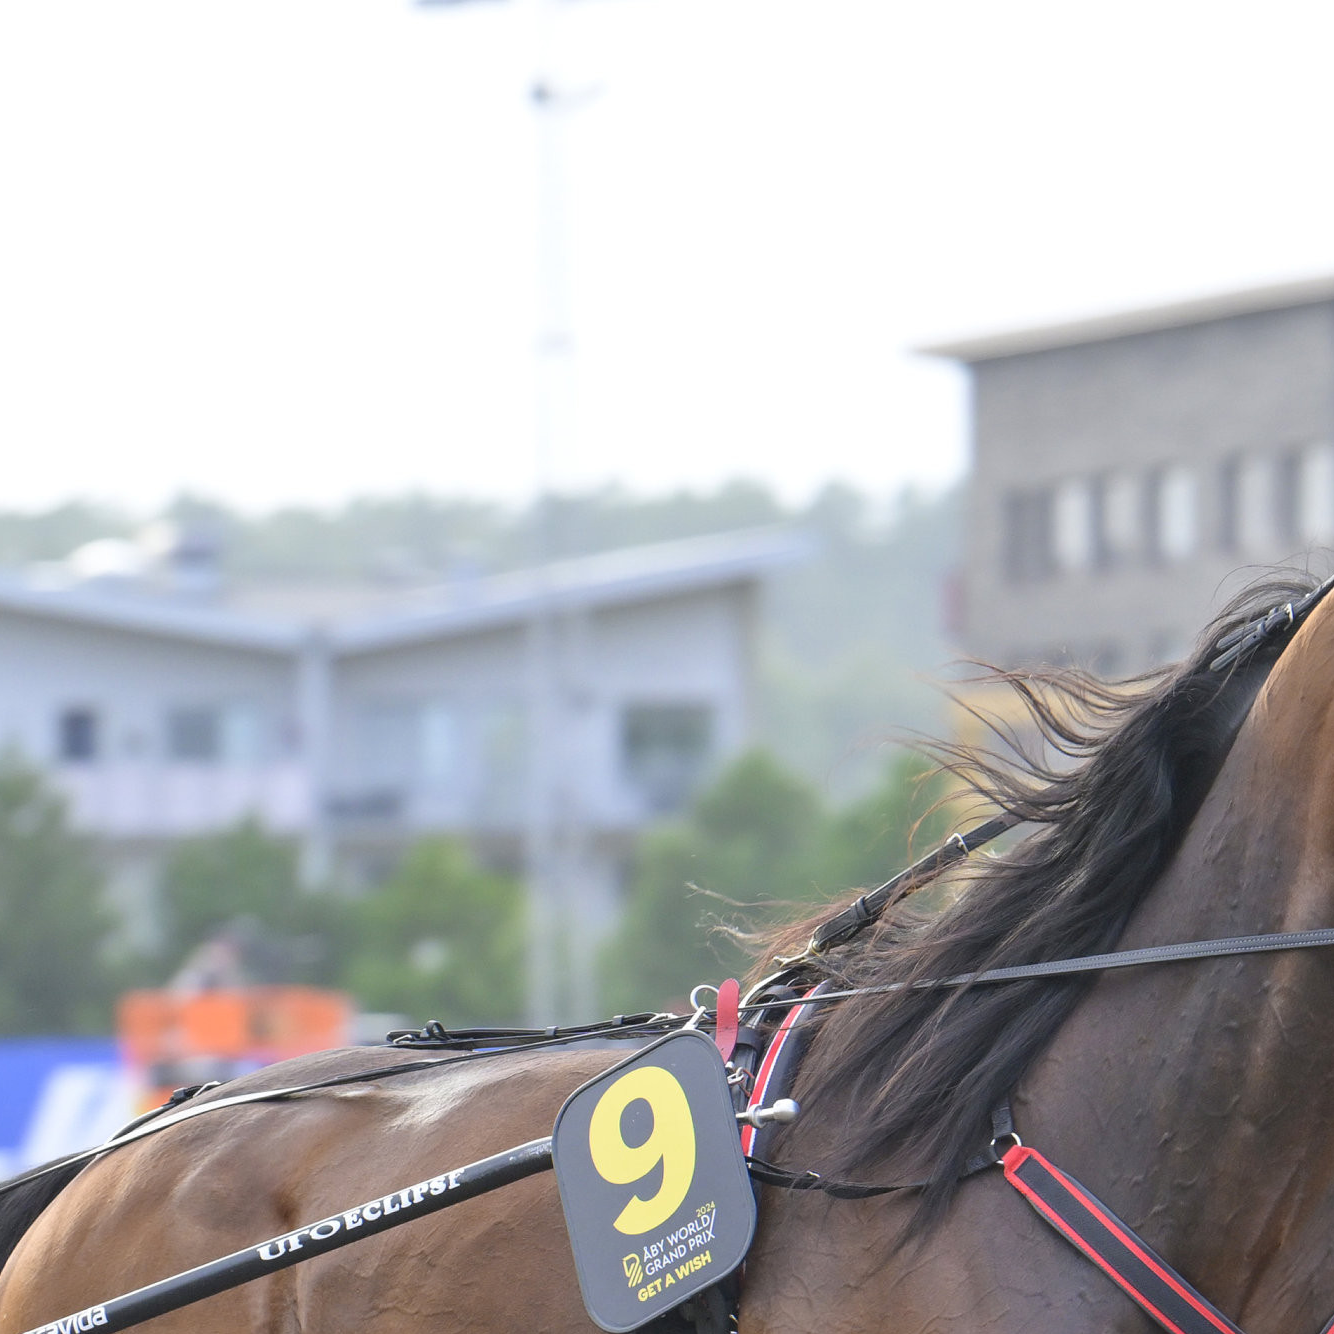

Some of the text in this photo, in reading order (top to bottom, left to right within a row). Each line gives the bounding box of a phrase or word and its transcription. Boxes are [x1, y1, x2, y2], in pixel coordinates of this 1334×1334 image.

[589, 1066, 696, 1234] 9
[696, 1201, 715, 1217] 2024
[643, 1214, 710, 1263] ÅBY WORLD
[645, 1208, 716, 1276] GRAND PRIX
[637, 1250, 712, 1302] GET A WISH
